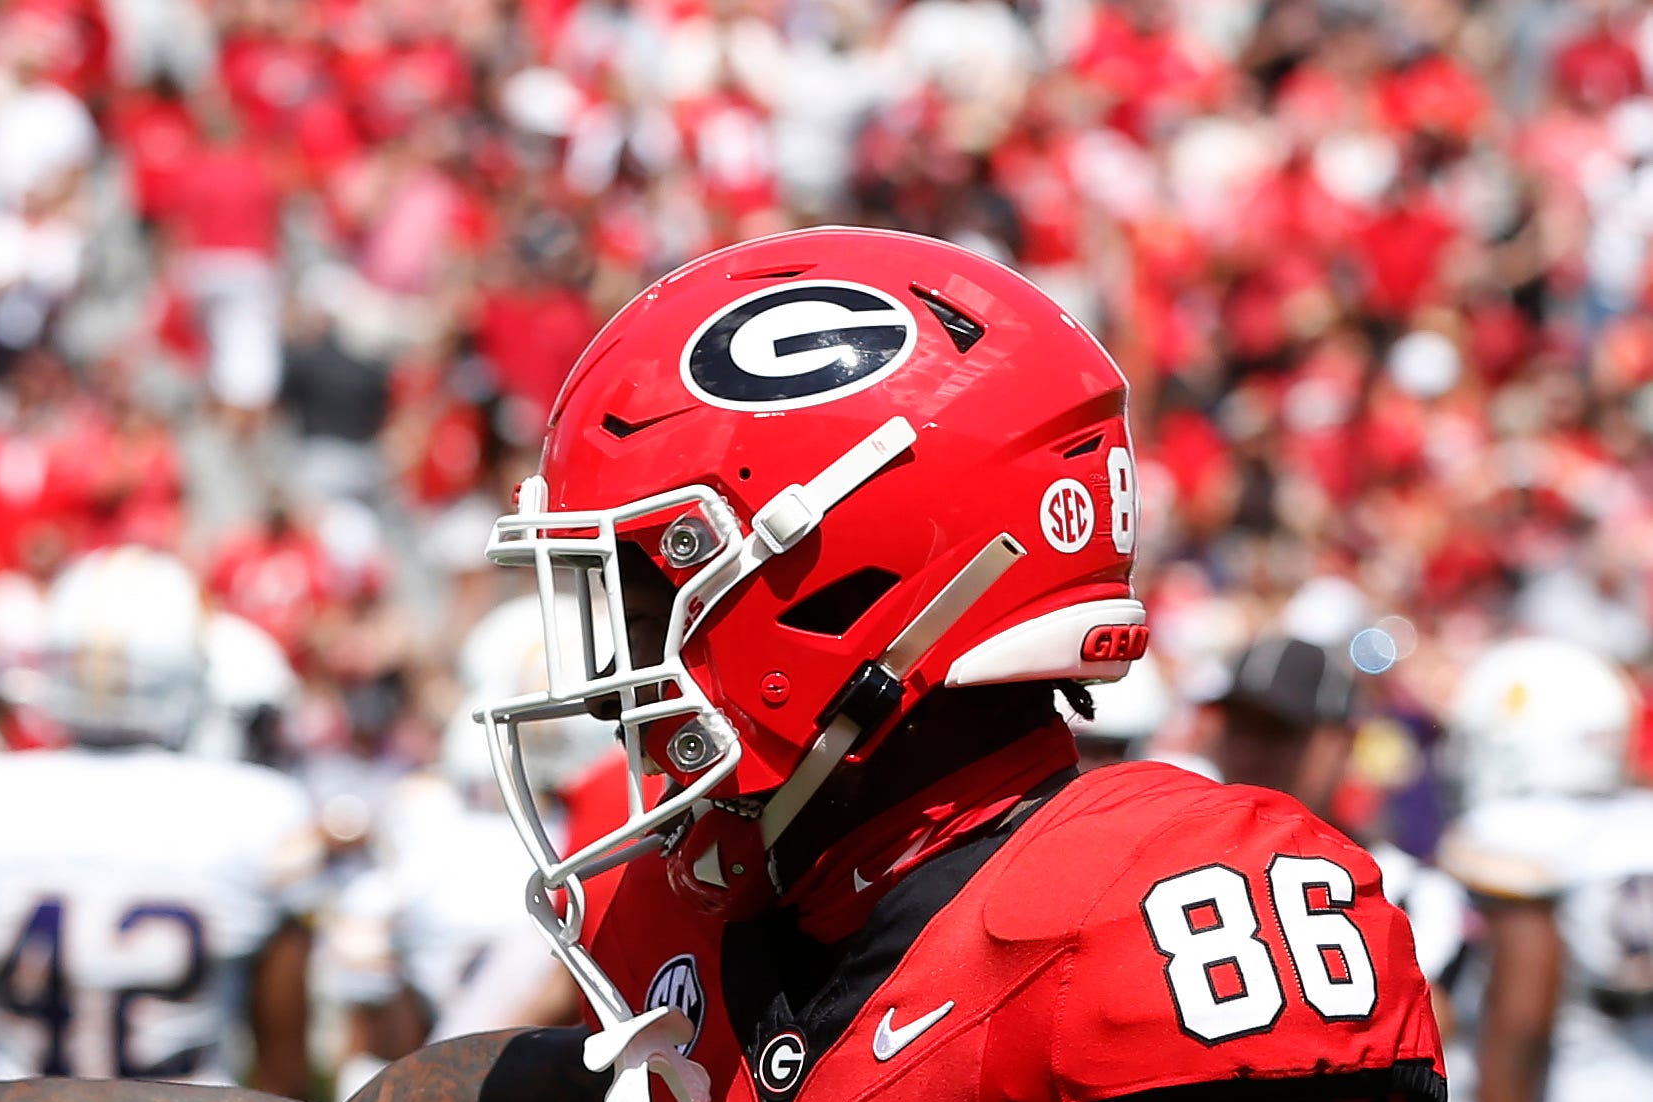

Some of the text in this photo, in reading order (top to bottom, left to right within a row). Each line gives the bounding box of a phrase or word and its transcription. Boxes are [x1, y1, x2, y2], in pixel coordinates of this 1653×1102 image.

[1046, 485, 1089, 546] SEC
[1141, 854, 1379, 1046] 86
[761, 1035, 804, 1091] G
